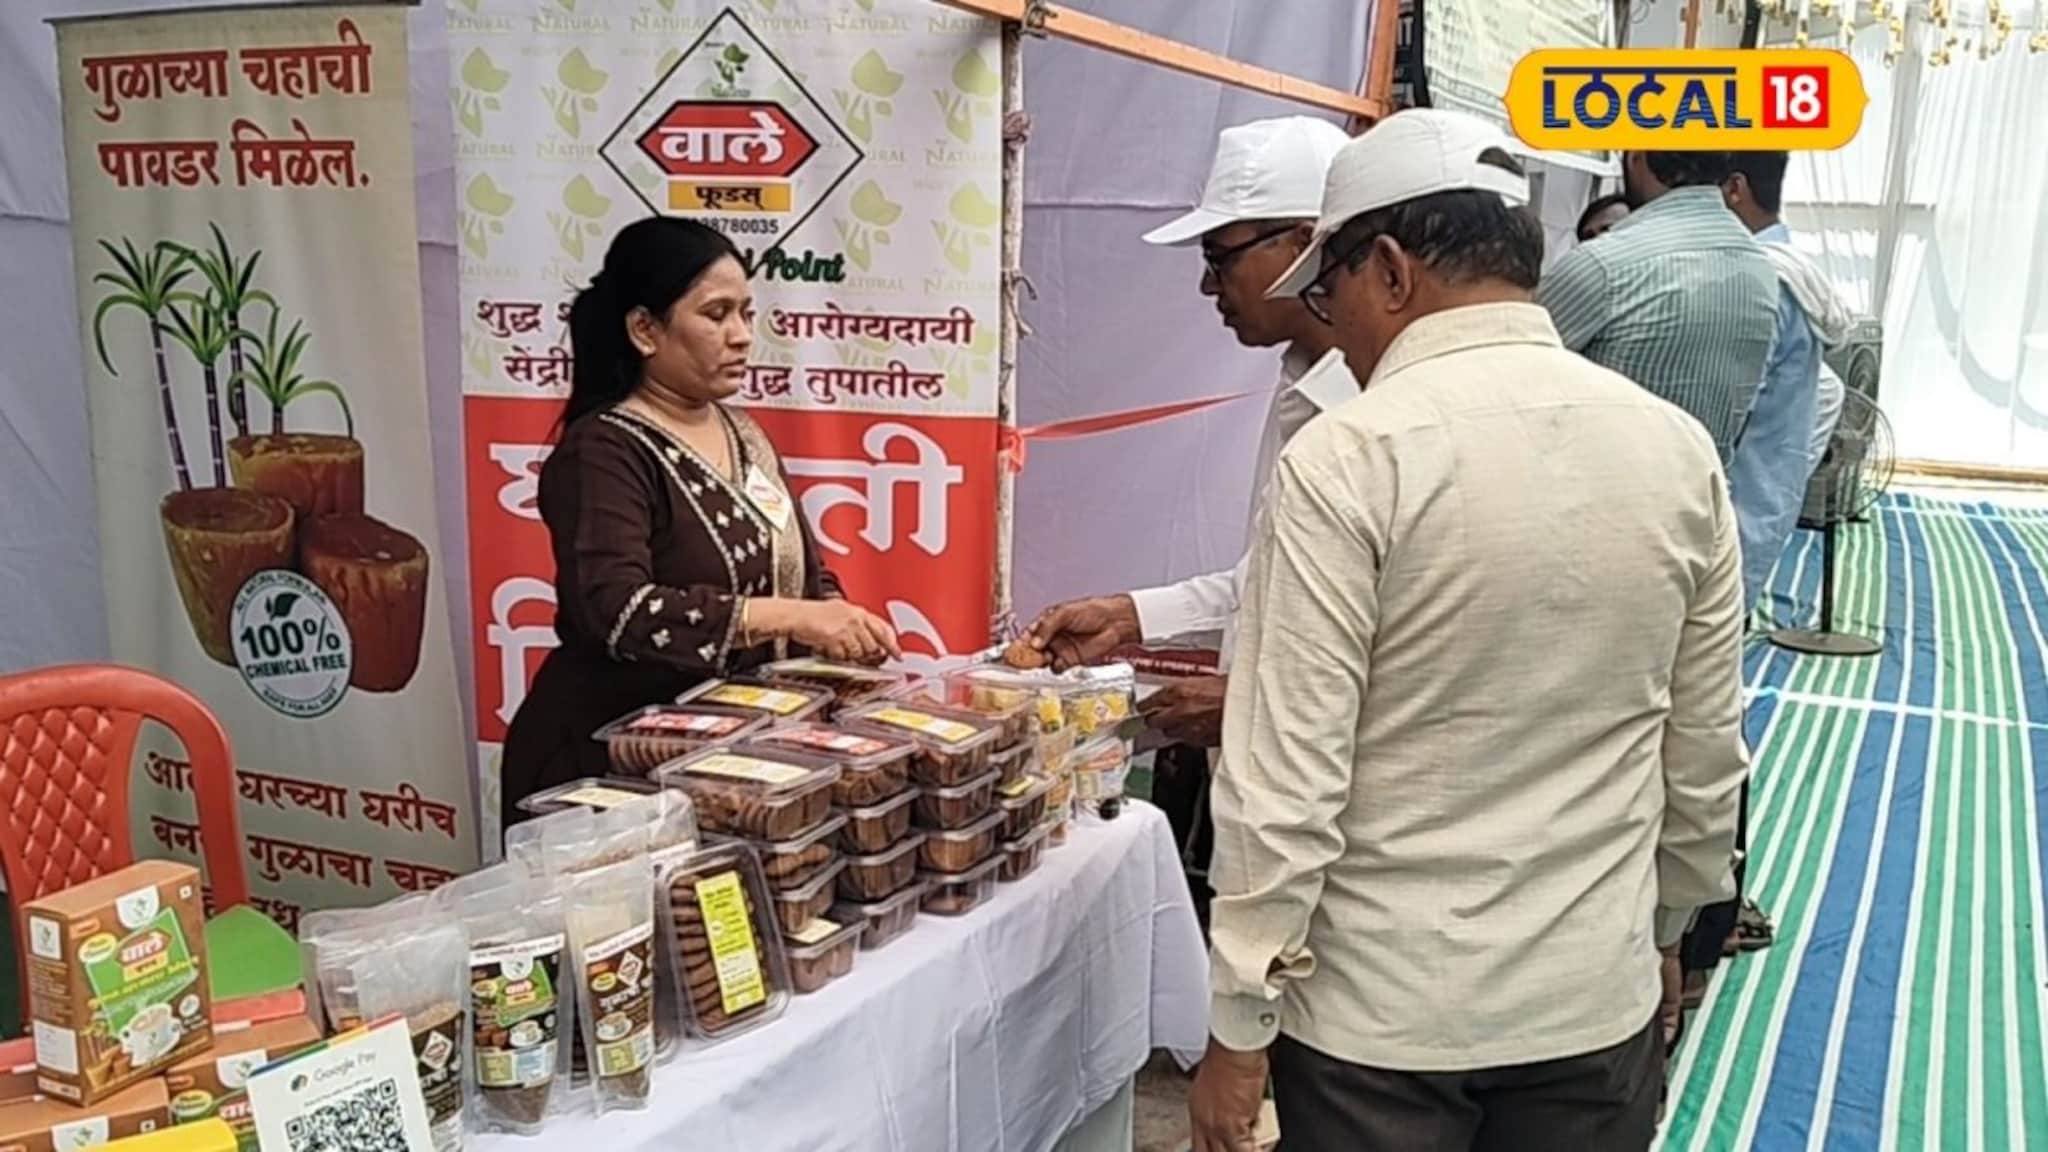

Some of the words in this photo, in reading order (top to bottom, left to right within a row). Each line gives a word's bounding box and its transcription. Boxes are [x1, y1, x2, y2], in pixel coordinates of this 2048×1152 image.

[82, 50, 228, 122] गुळाच्या
[240, 18, 371, 99] चहाची
[98, 142, 219, 187] पावडर
[231, 119, 370, 188] मिळेल.
[658, 111, 785, 163] वाले
[695, 186, 765, 210] फूडस्
[764, 248, 846, 282] Point
[477, 301, 544, 338] शुद्ध
[768, 302, 975, 347] आरोग्यदायी
[503, 345, 574, 388] सेंद्री
[805, 360, 945, 403] तुपातील
[240, 614, 341, 660] 100%
[246, 657, 310, 680] CHEMICAL
[312, 653, 348, 672] FREE
[236, 768, 349, 820] घरच्या
[359, 782, 456, 838] घरीच
[246, 834, 373, 888] गुळाचा
